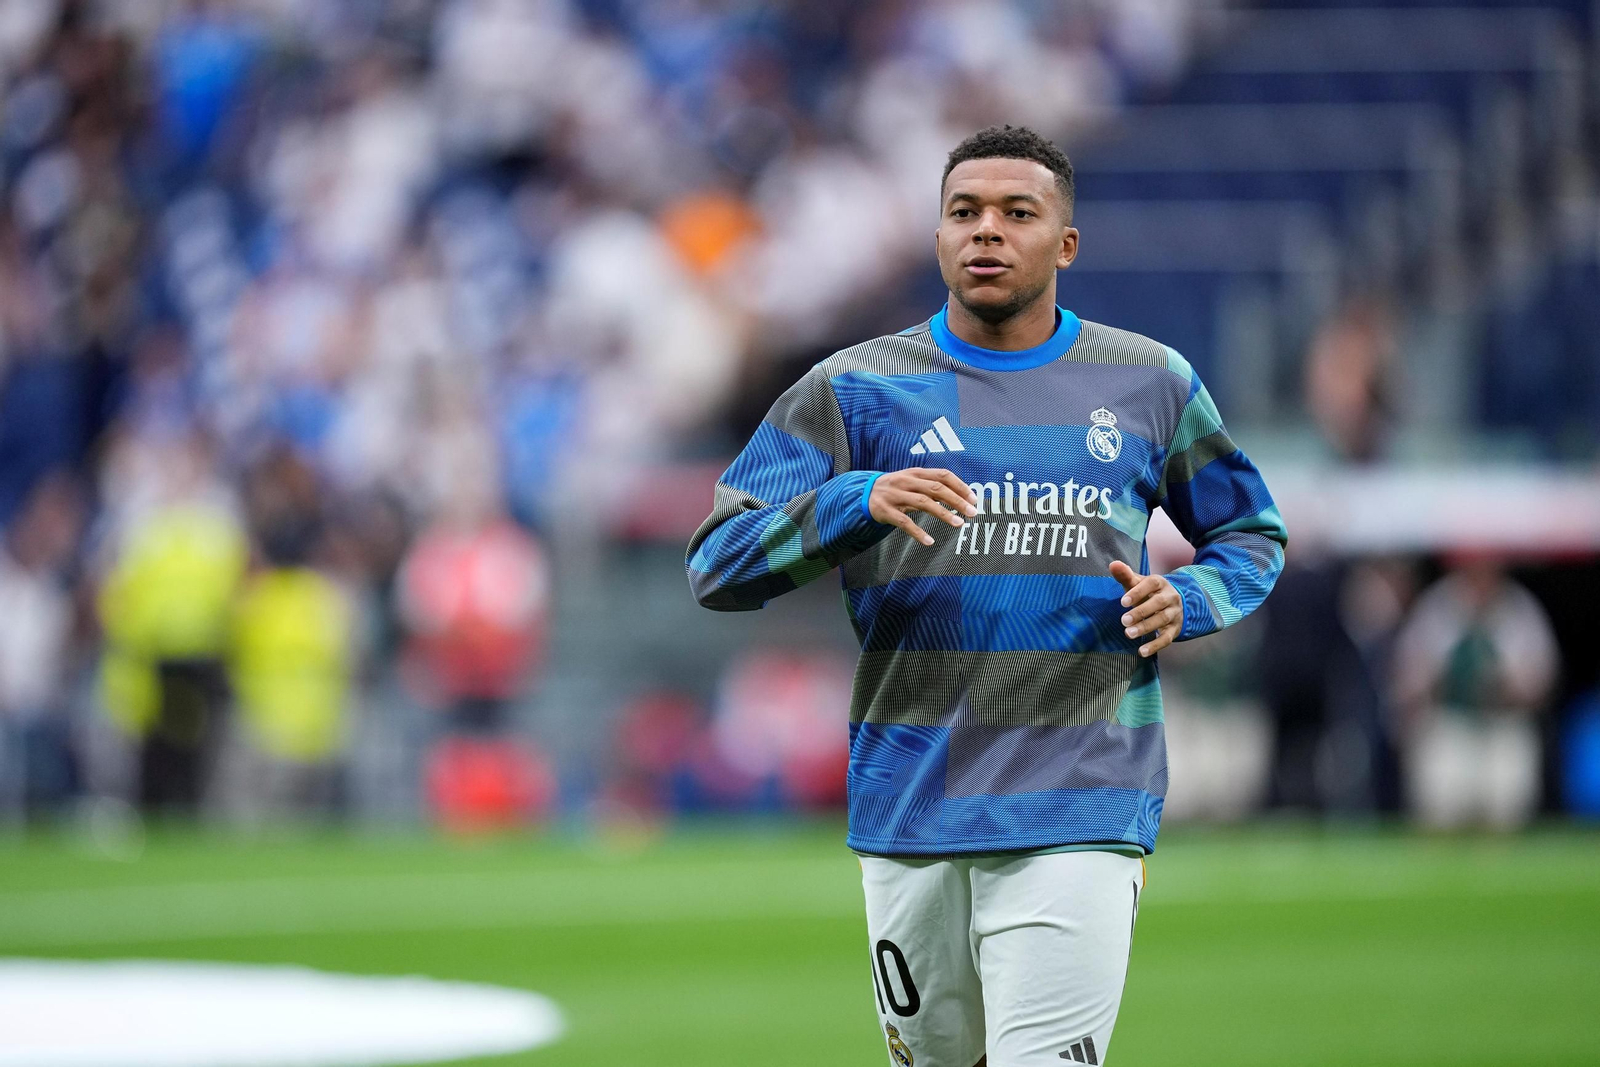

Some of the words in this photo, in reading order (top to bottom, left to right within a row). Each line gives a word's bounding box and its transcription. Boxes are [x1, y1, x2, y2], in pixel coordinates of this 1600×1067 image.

[950, 472, 1112, 520] mirates
[955, 522, 996, 555] FLY
[1004, 522, 1088, 558] BETTER
[869, 939, 921, 1017] 10
